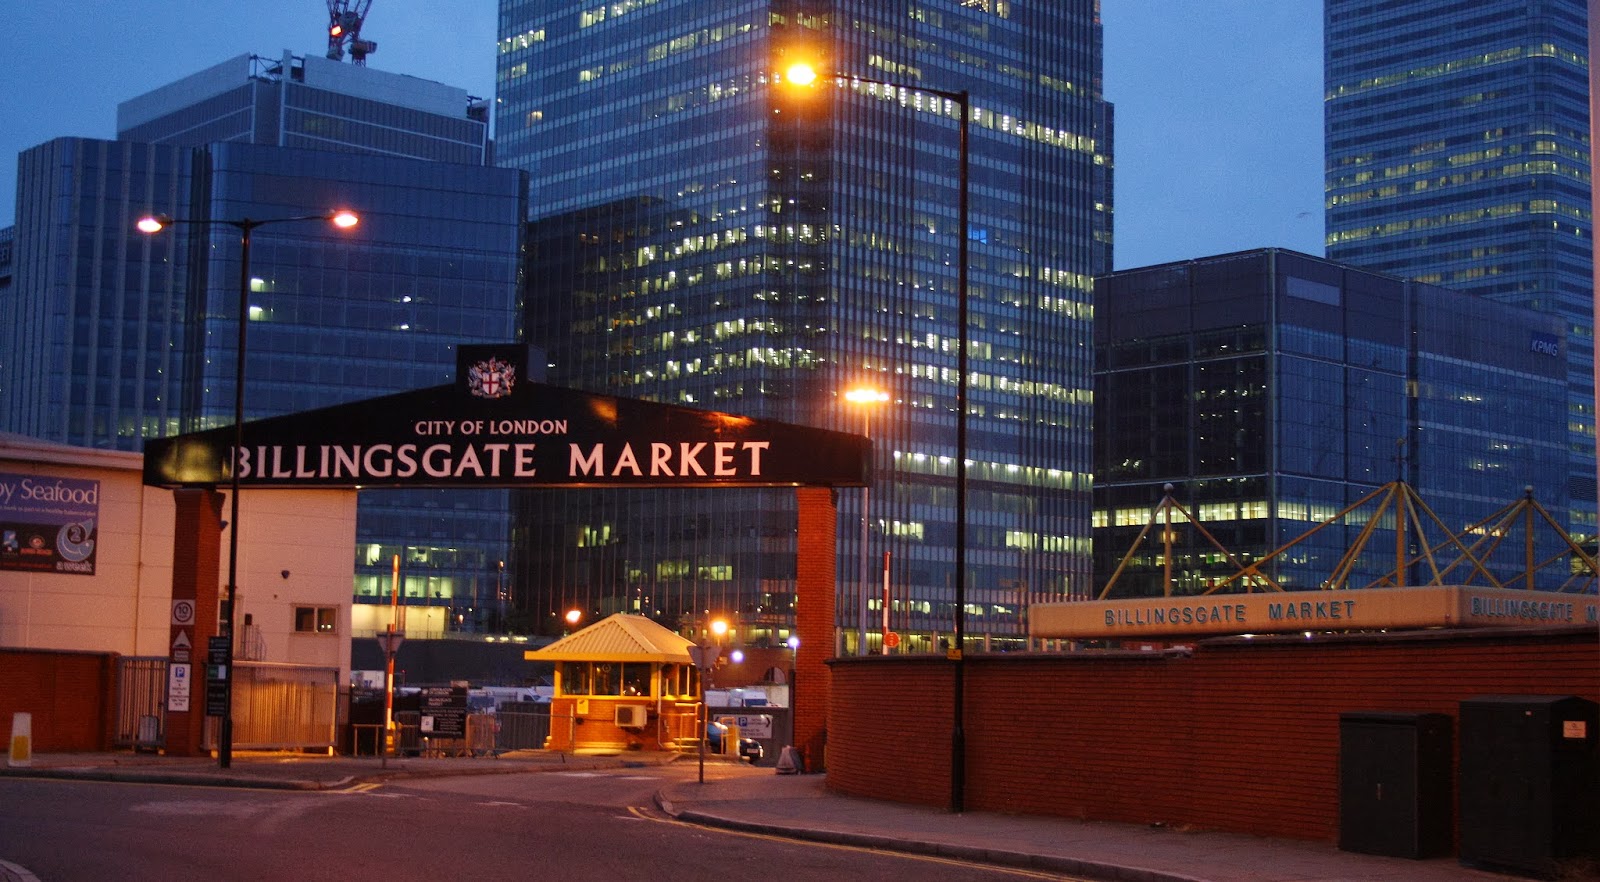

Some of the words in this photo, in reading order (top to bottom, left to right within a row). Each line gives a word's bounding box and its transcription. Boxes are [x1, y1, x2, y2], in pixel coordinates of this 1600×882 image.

[1531, 340, 1558, 356] KPMG
[415, 420, 456, 436] CITY
[460, 420, 484, 435] OF
[489, 419, 568, 435] LONDON
[230, 443, 537, 478] BILLINGSGATE
[568, 441, 770, 477] MARKET
[20, 478, 98, 506] Seafood
[70, 526, 82, 543] 2
[178, 605, 189, 614] 10
[1104, 604, 1247, 626] BILLINGSGATE
[1268, 600, 1356, 621] MARKET
[1471, 596, 1574, 622] BILLINGSGATE
